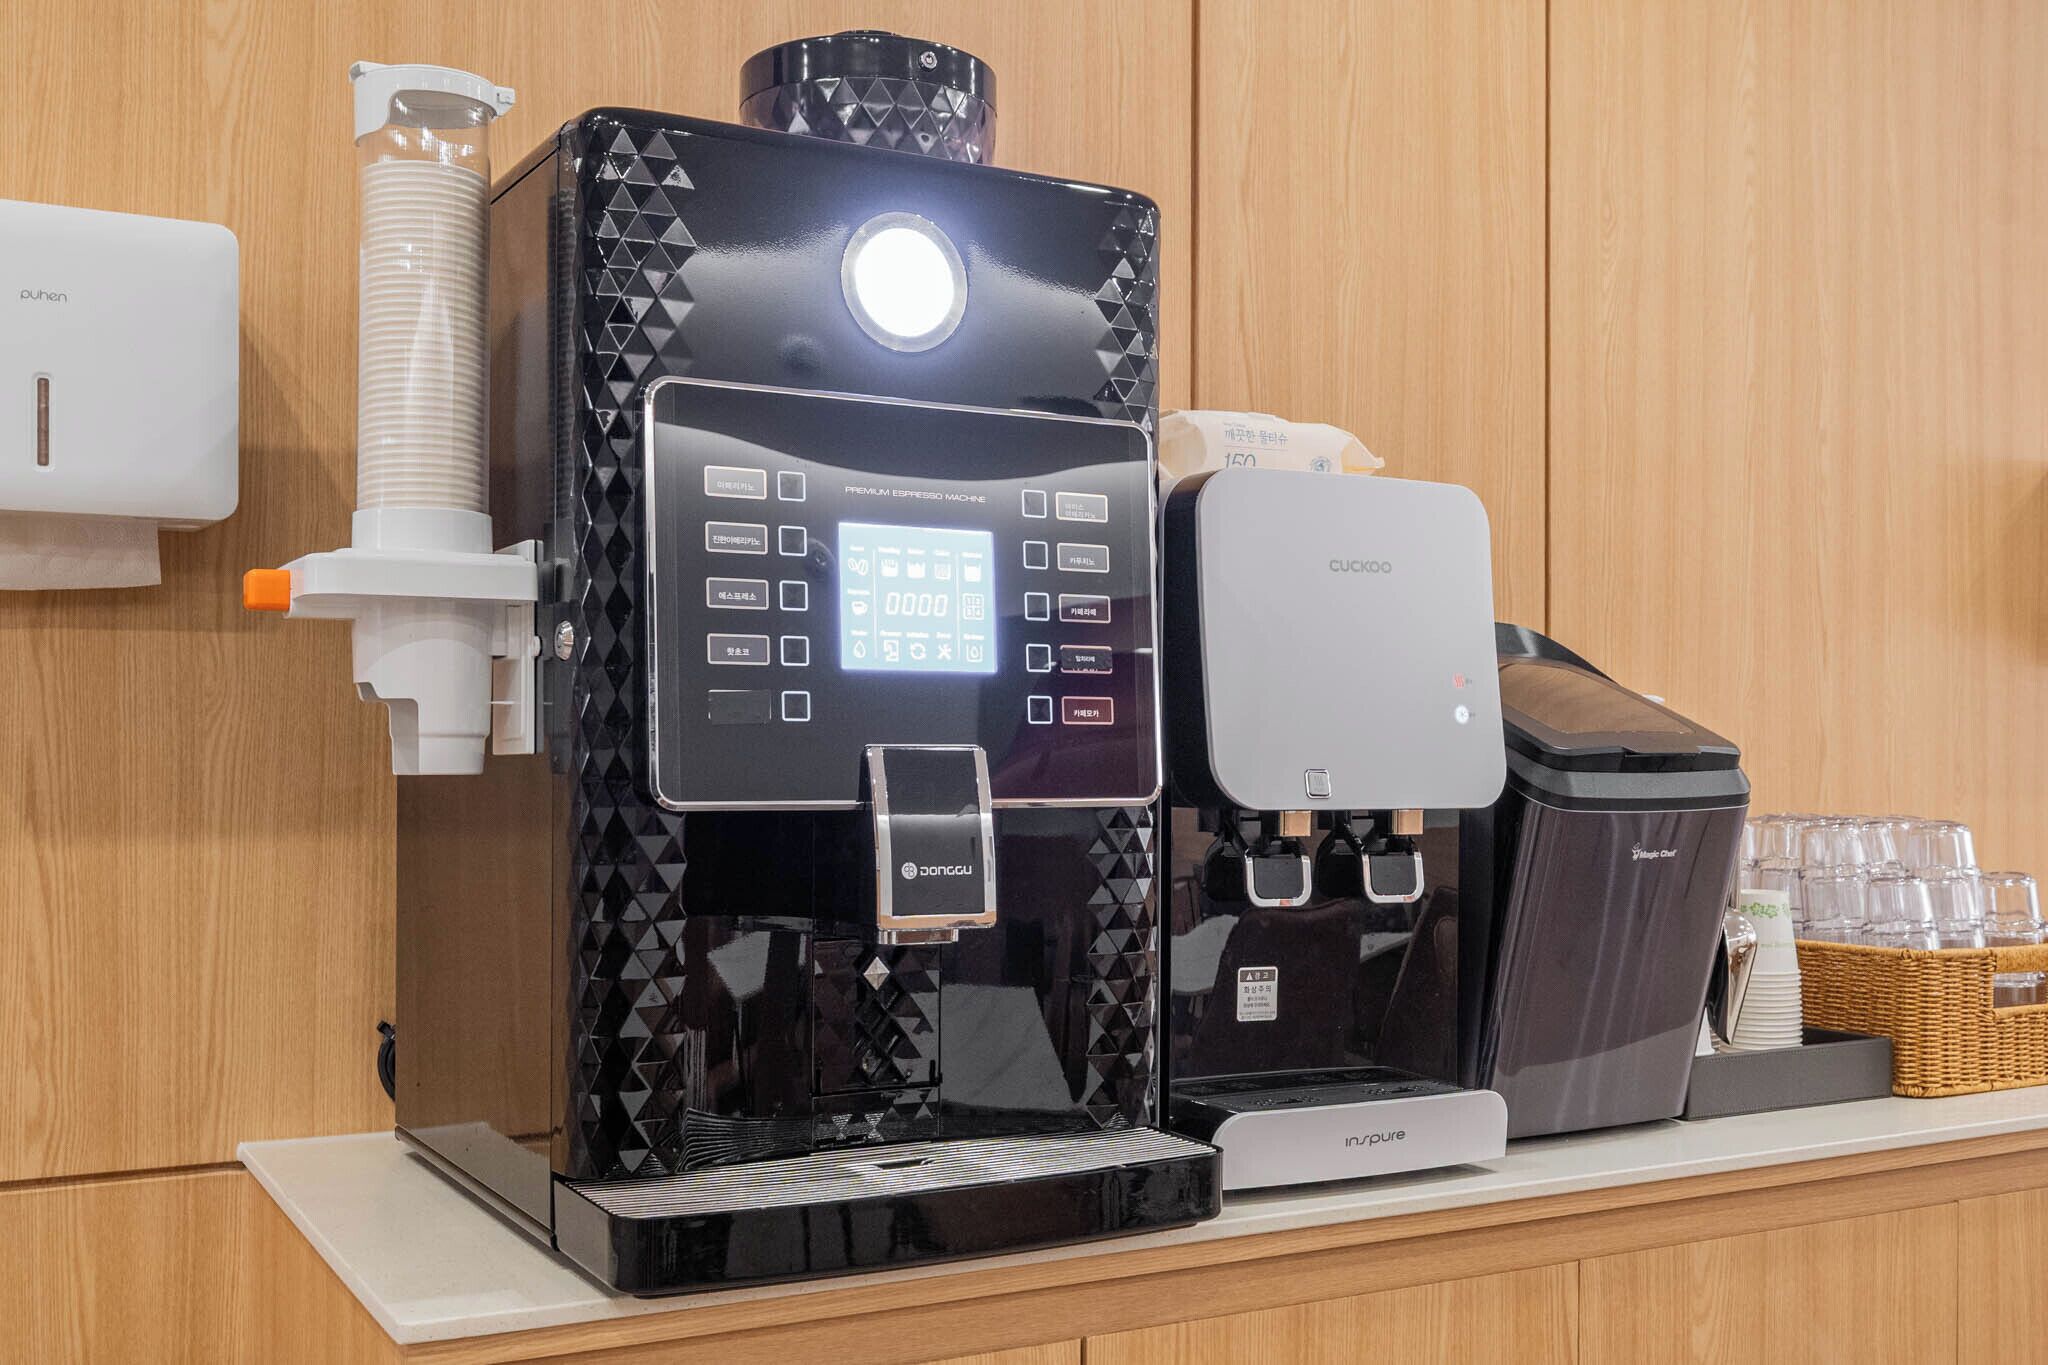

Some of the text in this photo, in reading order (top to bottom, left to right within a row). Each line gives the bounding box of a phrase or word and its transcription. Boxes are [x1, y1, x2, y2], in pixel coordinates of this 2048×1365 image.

[20, 289, 67, 303] puhen
[845, 486, 986, 503] PREMIUM ESPRESSO MACHINE
[1329, 559, 1392, 574] CUCKOO
[718, 591, 757, 601] 에스프레소
[885, 592, 949, 617] 0000
[1345, 1130, 1406, 1147] inspure
